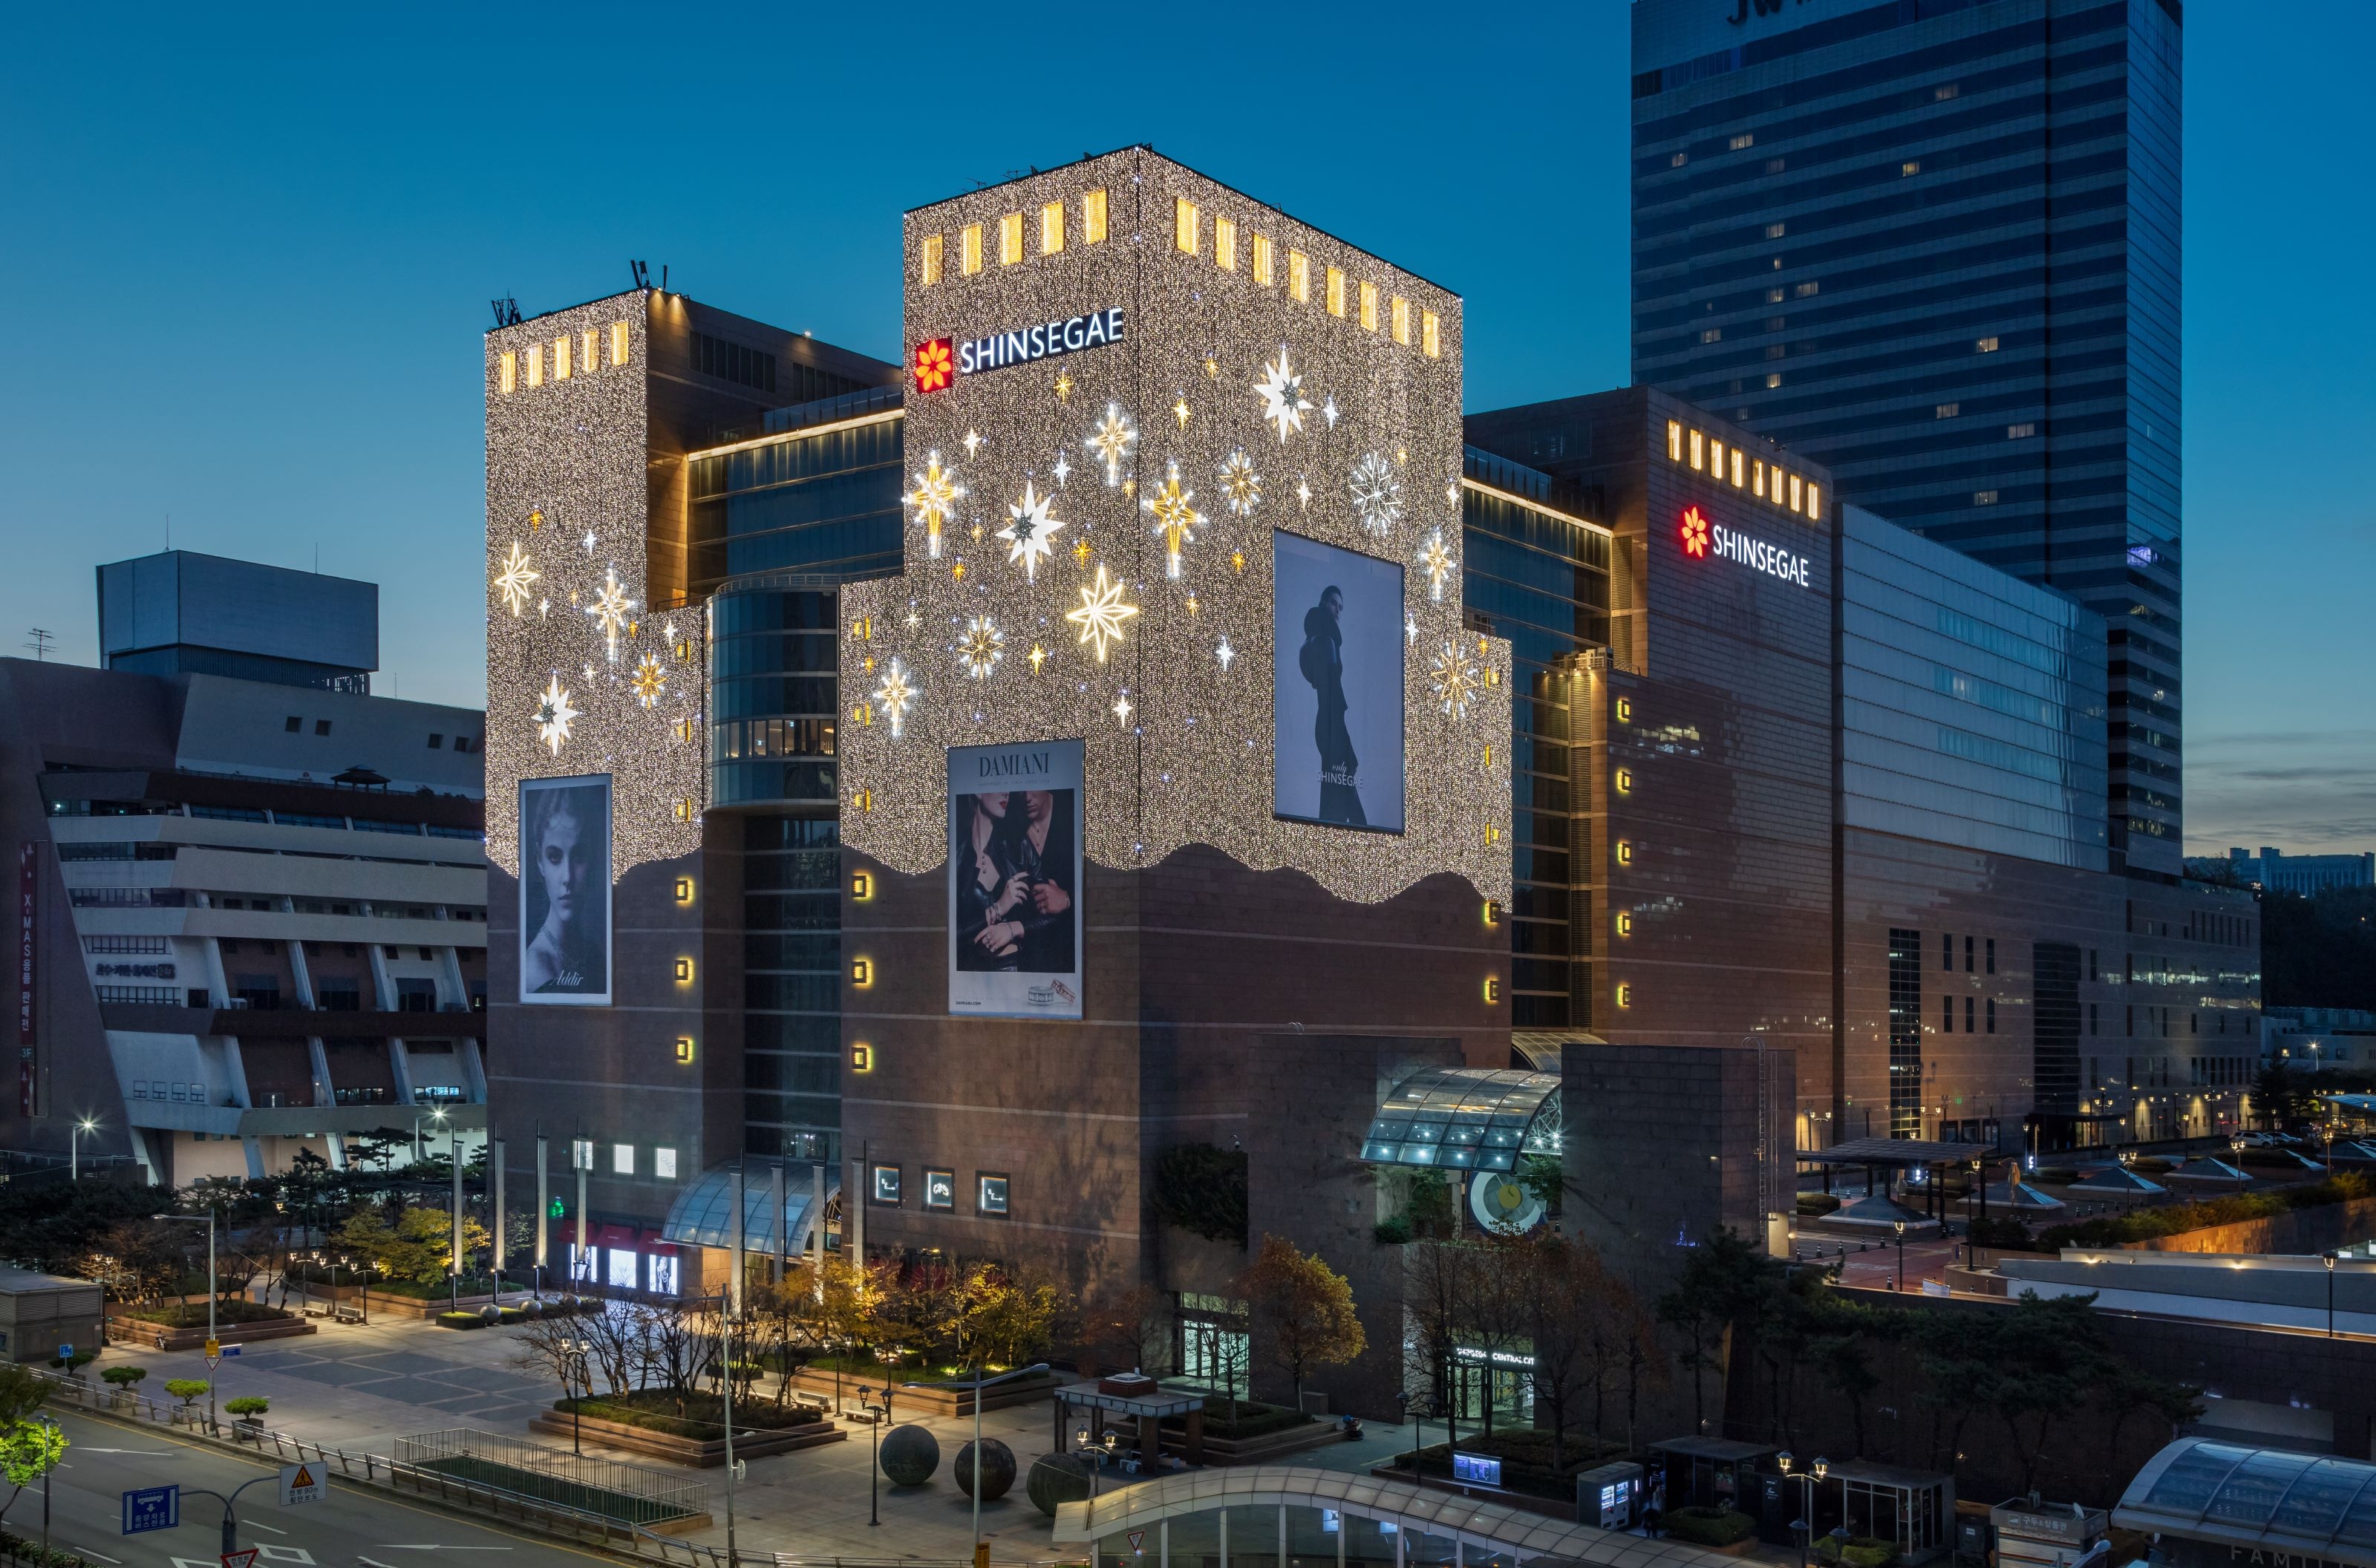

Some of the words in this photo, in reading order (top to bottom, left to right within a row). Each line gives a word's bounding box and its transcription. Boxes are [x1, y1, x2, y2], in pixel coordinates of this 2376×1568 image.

[961, 307, 1123, 373] SHINSEGAE
[1713, 525, 1809, 587] SHINSEGAE
[979, 752, 1049, 777] DAMIANI
[1332, 761, 1347, 777] only
[1316, 771, 1364, 788] SHINSEGAE
[1524, 1356, 1535, 1365] CIT
[304, 1486, 319, 1494] 90m
[135, 1518, 166, 1529] 버스전용
